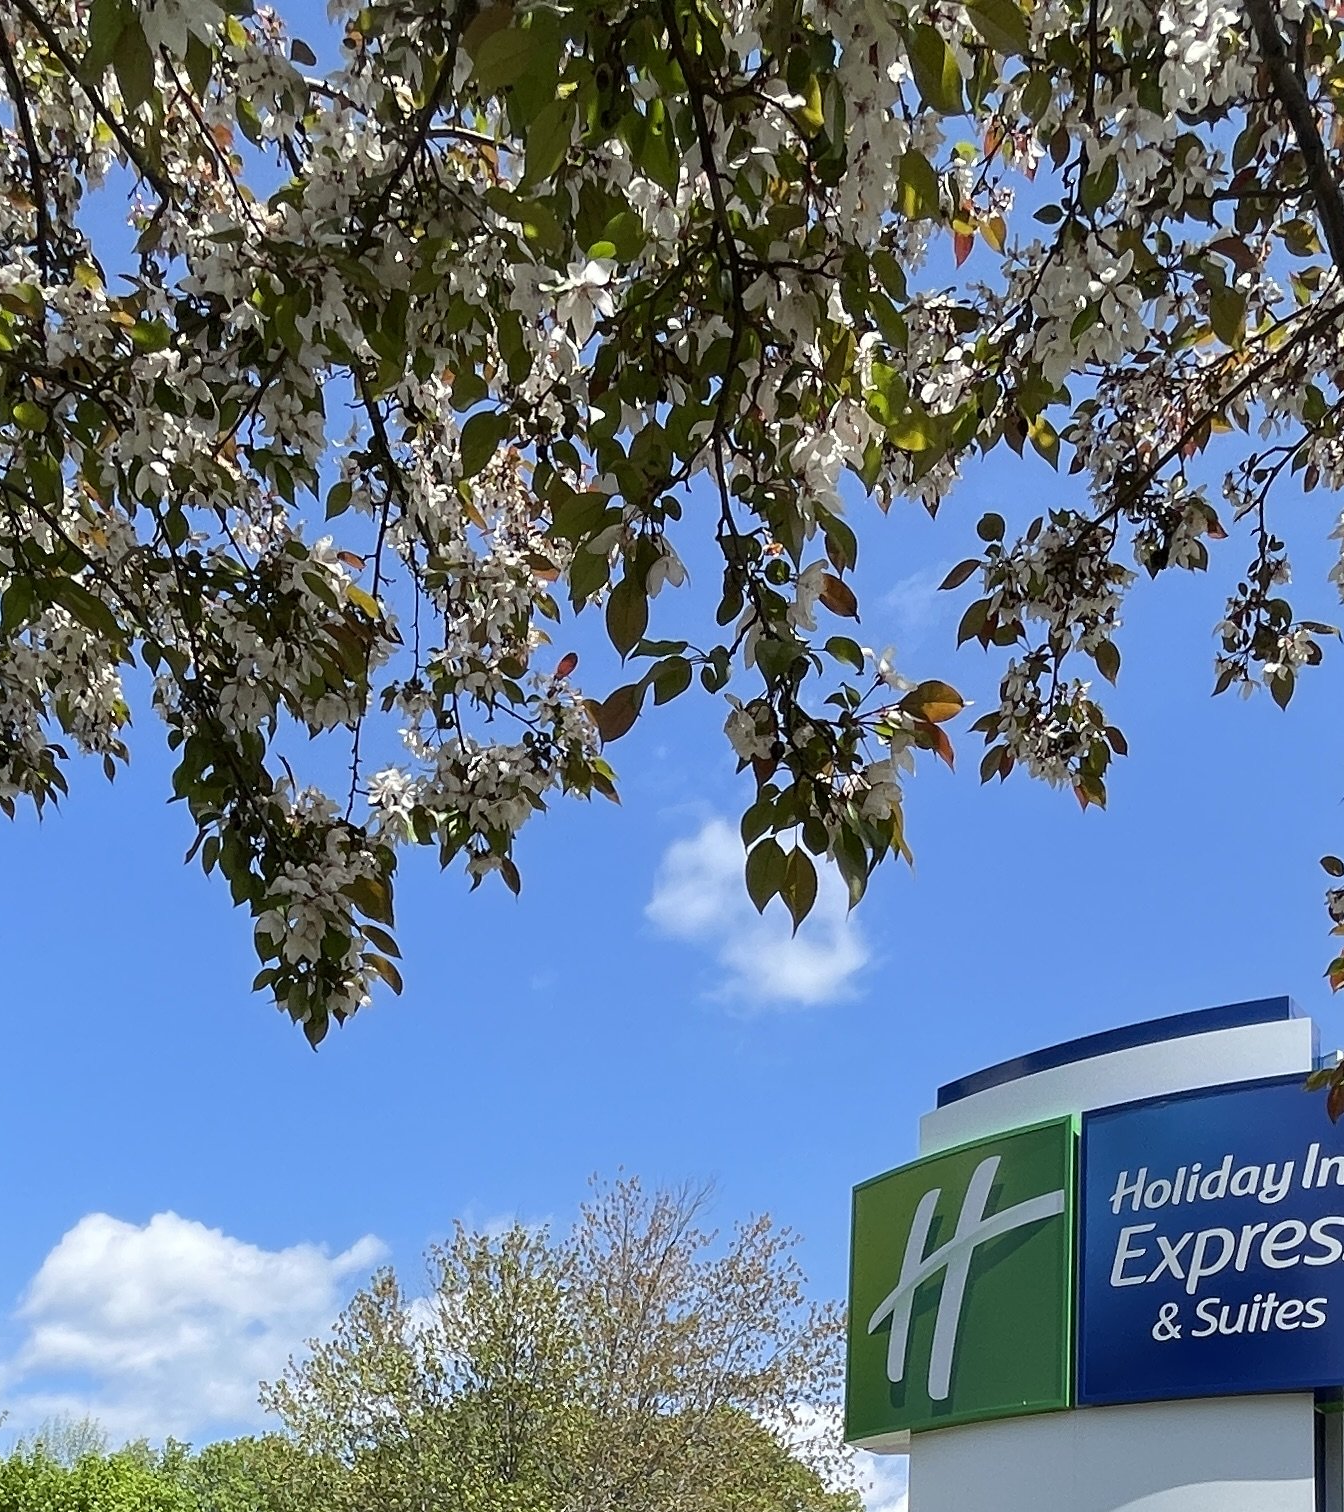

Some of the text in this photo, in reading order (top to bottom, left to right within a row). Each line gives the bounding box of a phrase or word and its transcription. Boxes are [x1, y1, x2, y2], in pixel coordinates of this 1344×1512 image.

[1109, 1154, 1295, 1215] Holiday
[868, 1155, 1064, 1400] H
[1152, 1293, 1328, 1341] & Suites
